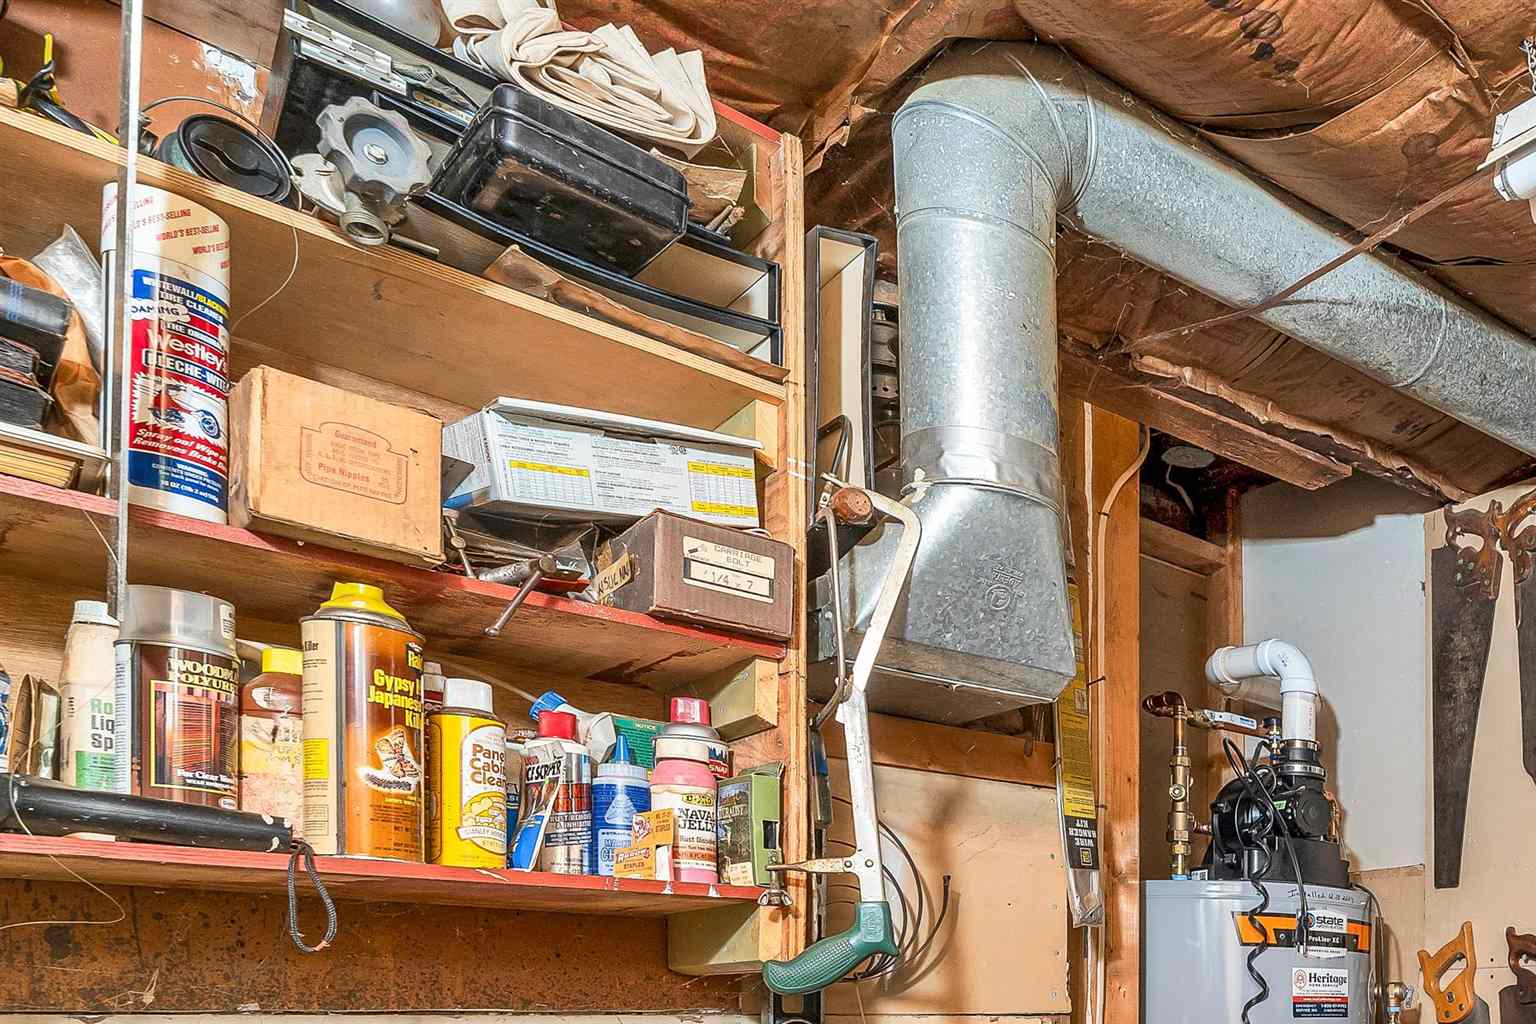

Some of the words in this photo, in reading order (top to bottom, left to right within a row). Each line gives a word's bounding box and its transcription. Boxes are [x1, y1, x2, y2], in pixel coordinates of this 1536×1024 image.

[130, 304, 180, 317] OAMING
[713, 543, 763, 564] CARRIAGE
[408, 650, 425, 671] Rai
[373, 668, 416, 692] Gypsy
[90, 698, 113, 714] Ro
[367, 684, 424, 711] Japanes
[90, 714, 115, 735] Liq
[405, 708, 424, 730] Kil
[91, 733, 113, 751] Sp
[472, 743, 505, 763] Pane
[470, 758, 505, 775] Cabi
[1316, 916, 1344, 926] state
[1308, 972, 1348, 986] Heritage
